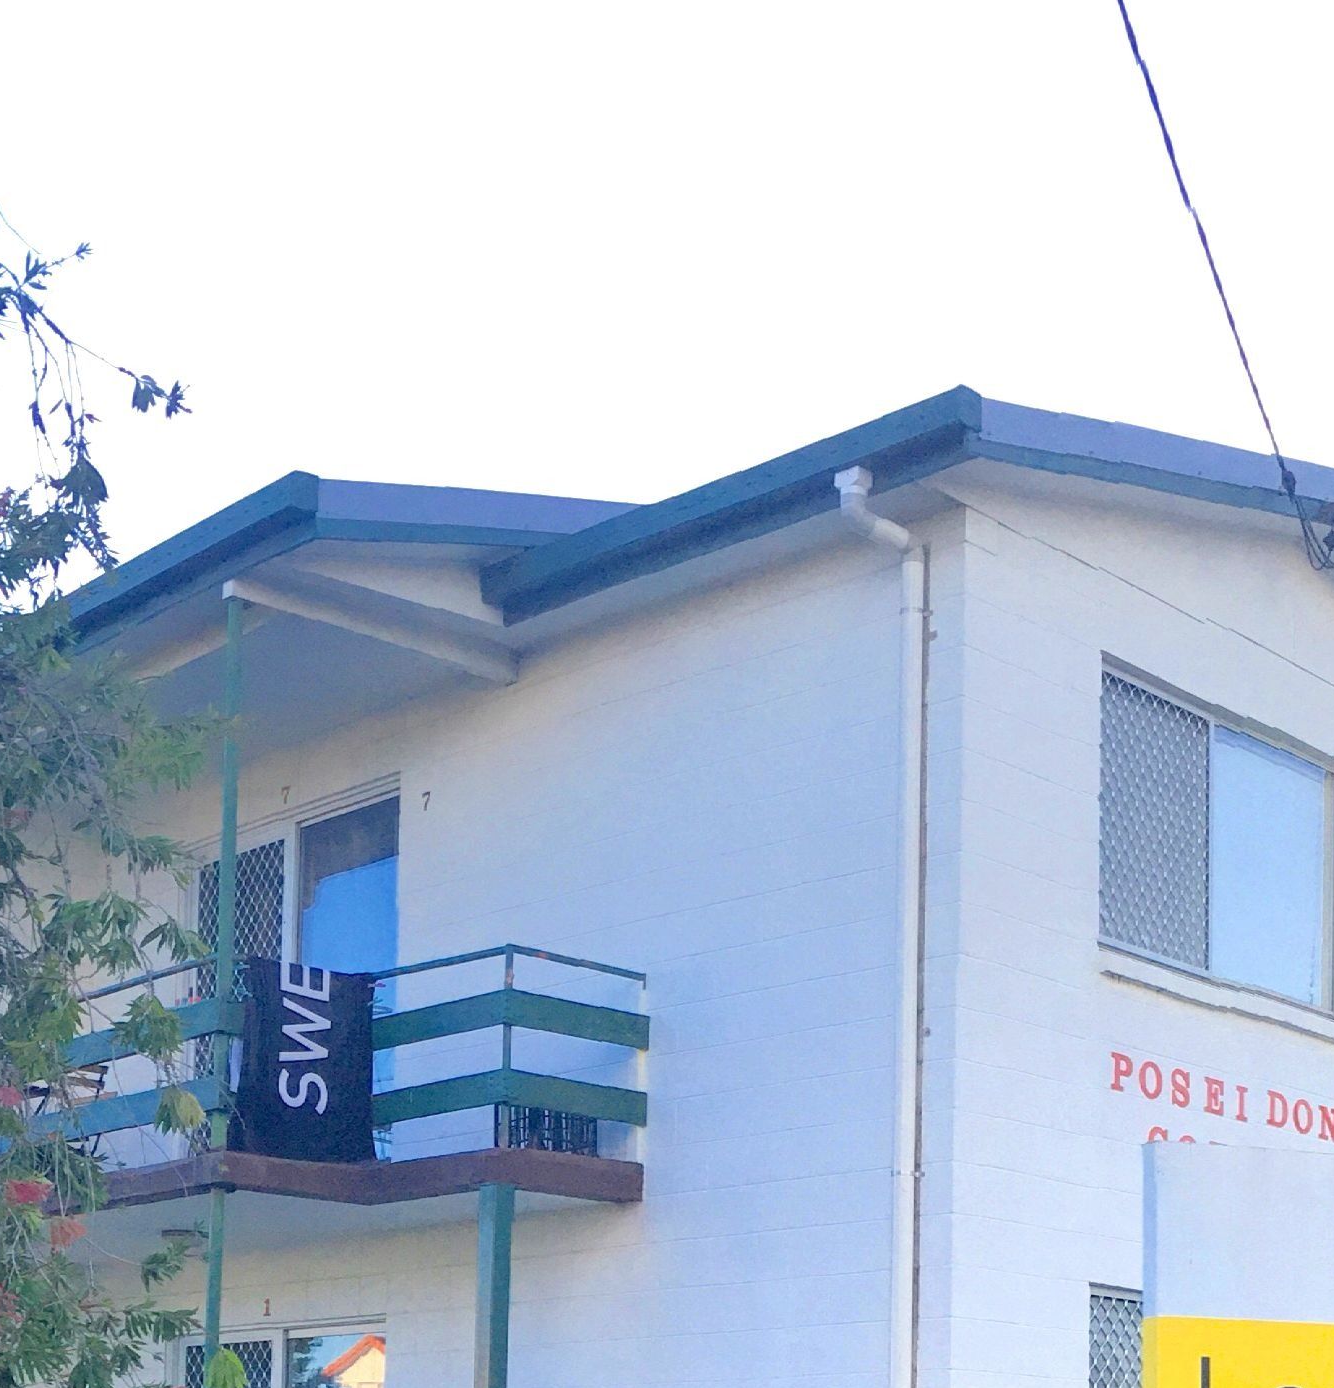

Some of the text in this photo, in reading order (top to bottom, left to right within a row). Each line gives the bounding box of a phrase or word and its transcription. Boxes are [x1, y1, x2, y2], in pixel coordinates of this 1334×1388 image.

[281, 785, 291, 805] 7
[422, 791, 431, 811] 7
[263, 1298, 271, 1317] 1
